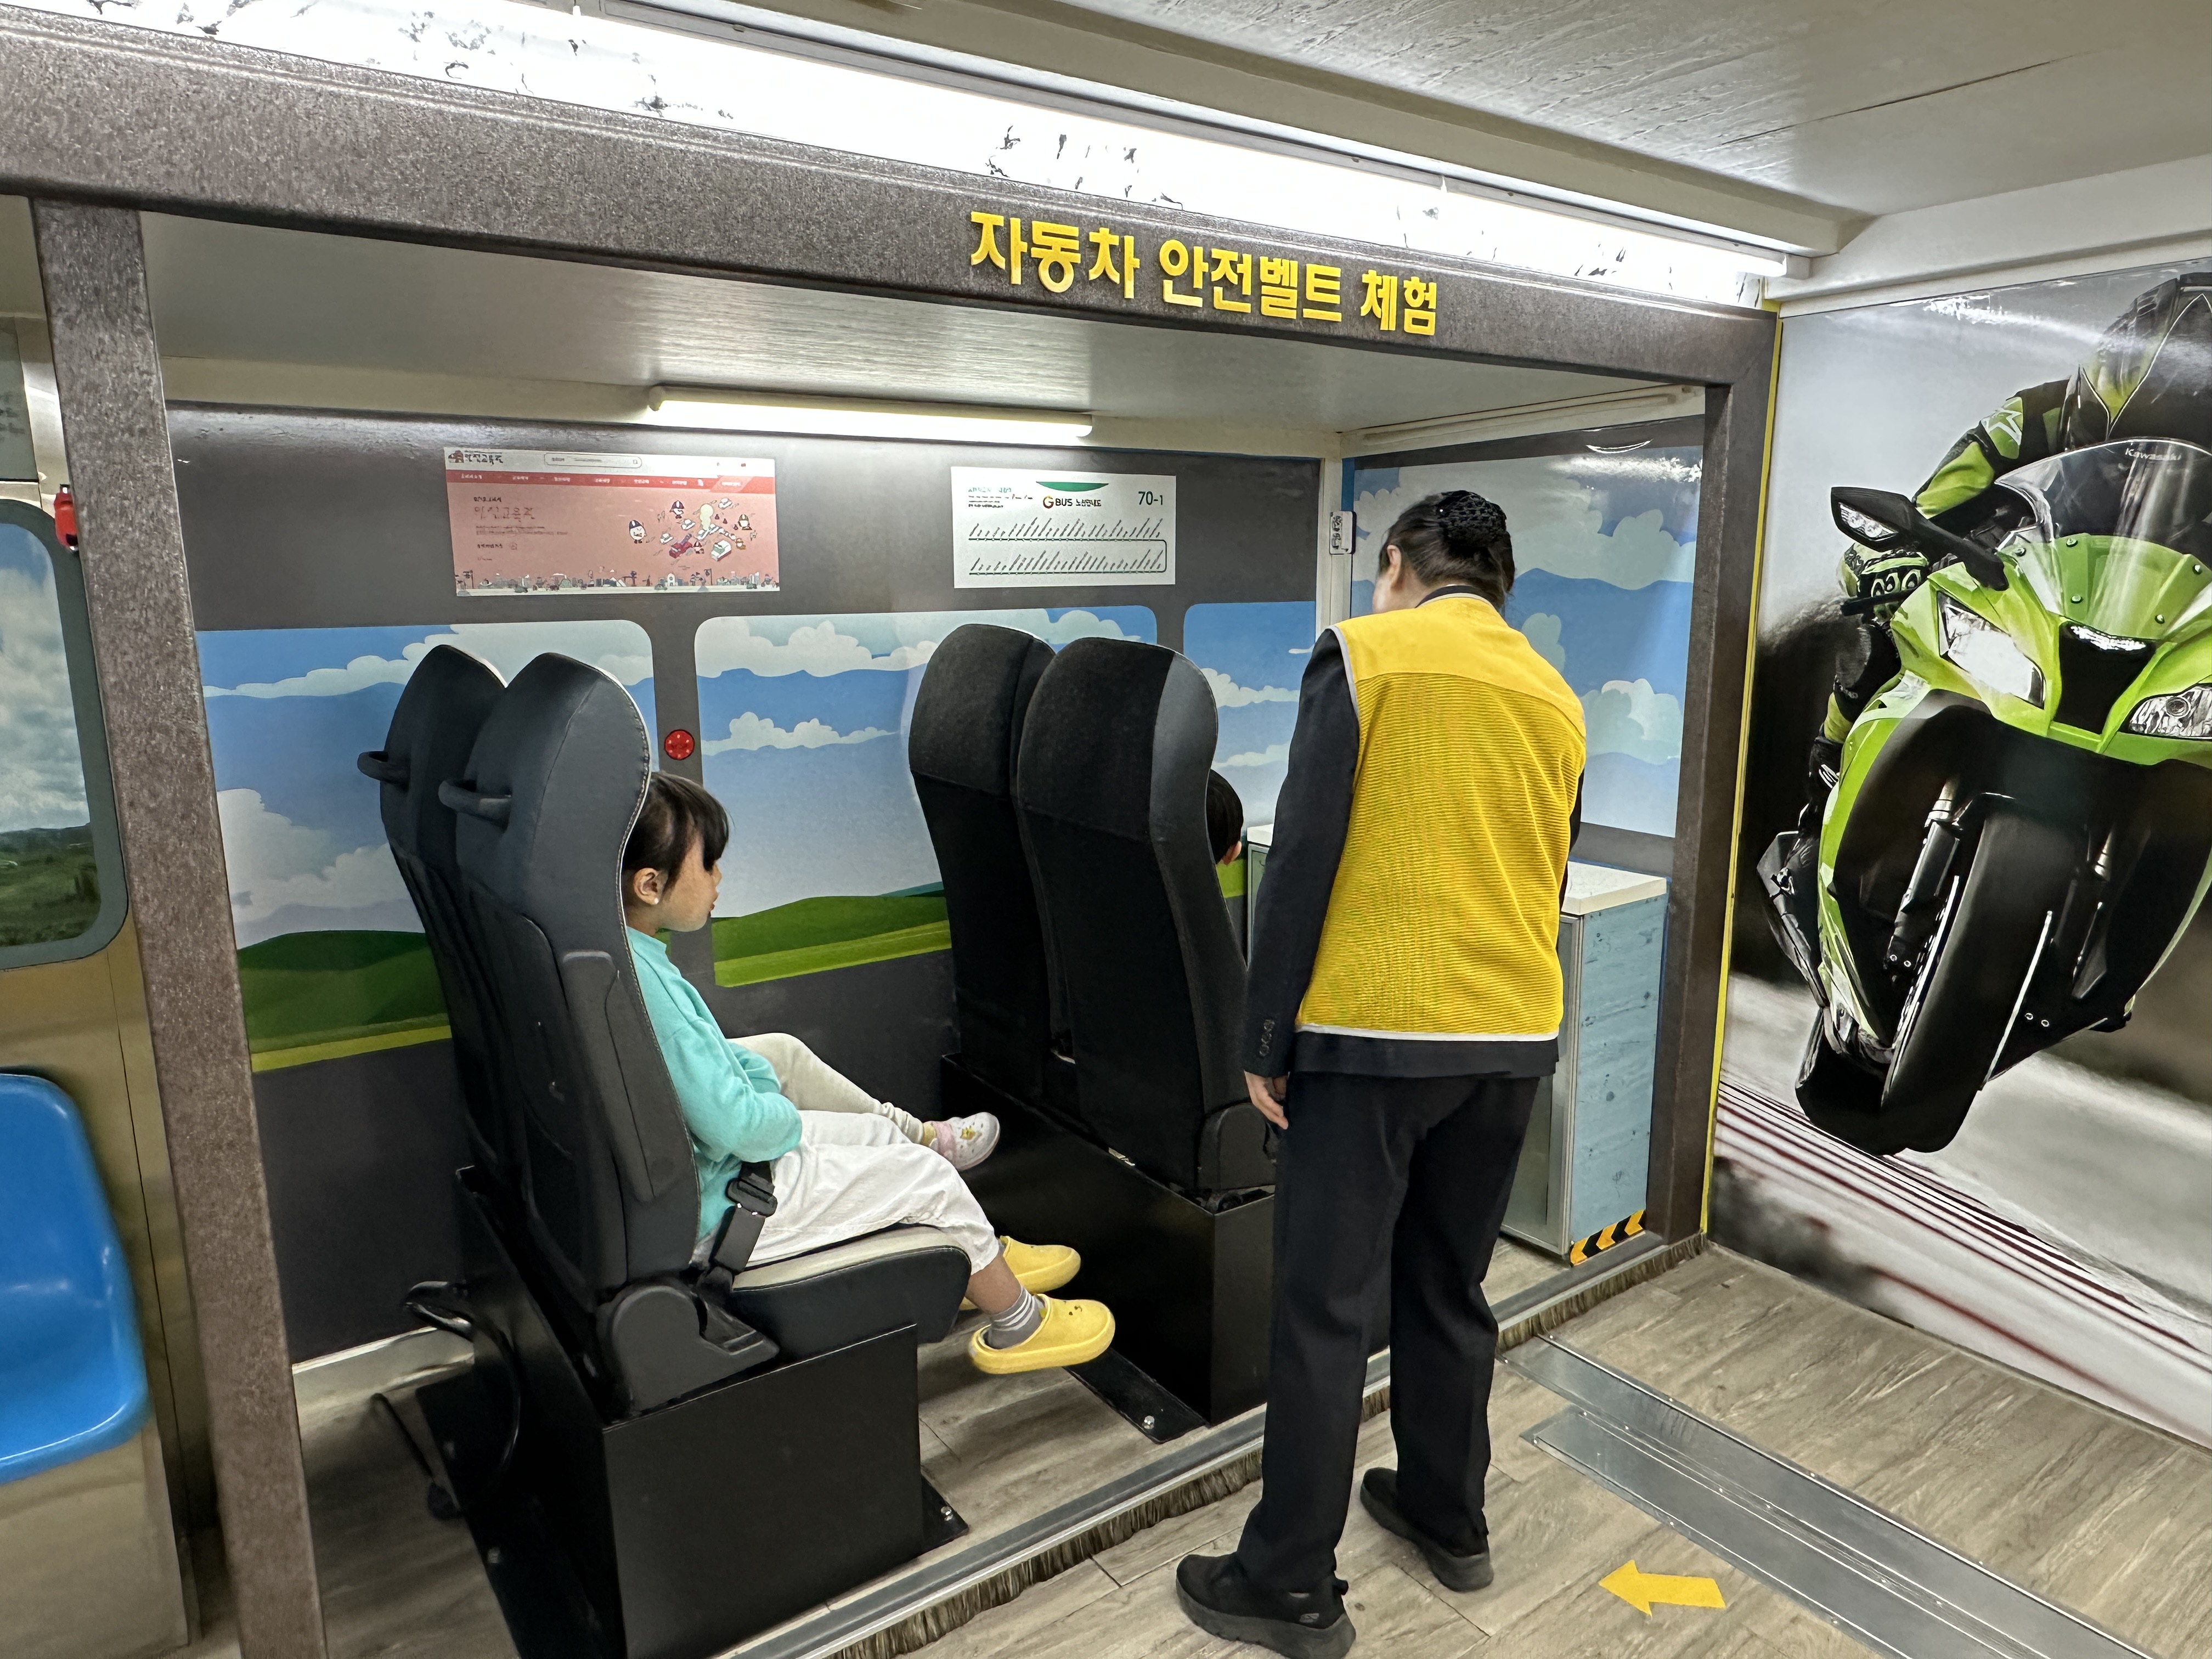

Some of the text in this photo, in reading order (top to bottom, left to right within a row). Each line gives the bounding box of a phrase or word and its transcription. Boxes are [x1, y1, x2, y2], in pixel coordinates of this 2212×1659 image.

[970, 211, 1437, 336] 자동차 안전벨트 체험
[1138, 491, 1163, 505] 70-1
